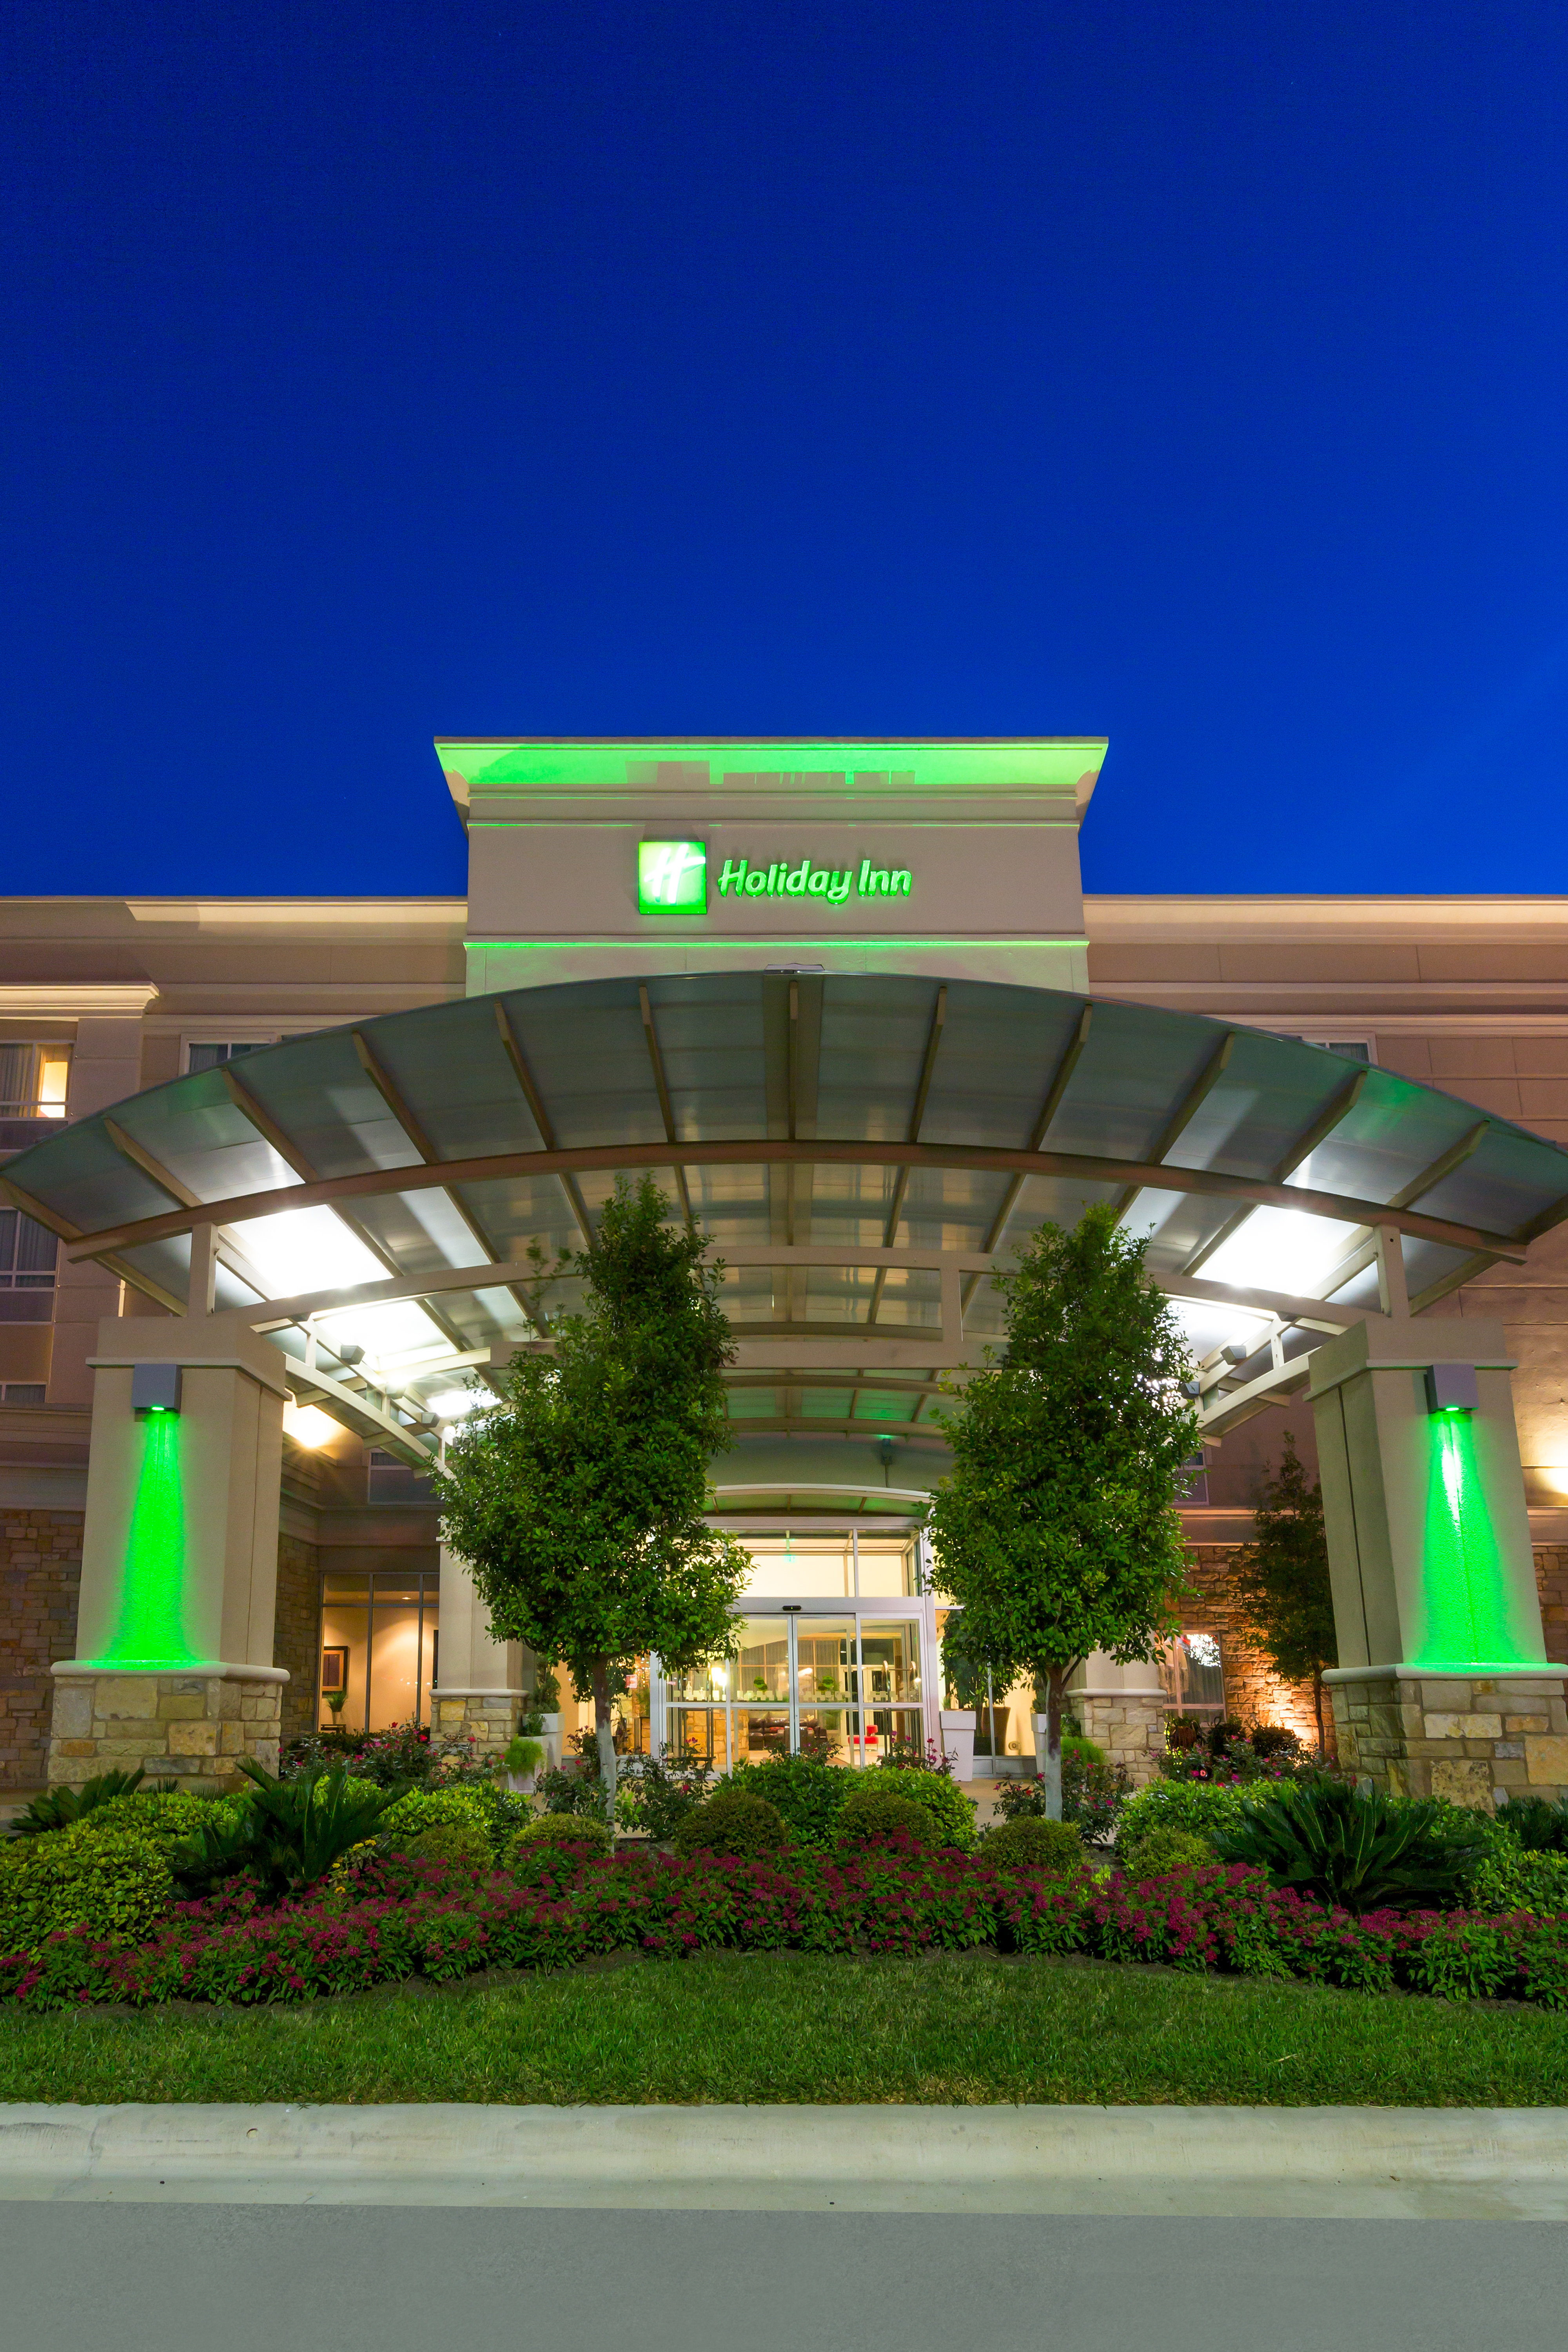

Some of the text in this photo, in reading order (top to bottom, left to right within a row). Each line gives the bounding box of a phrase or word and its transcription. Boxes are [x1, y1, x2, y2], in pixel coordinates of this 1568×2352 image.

[644, 844, 706, 904] H
[718, 860, 911, 904] Holiday Inn
